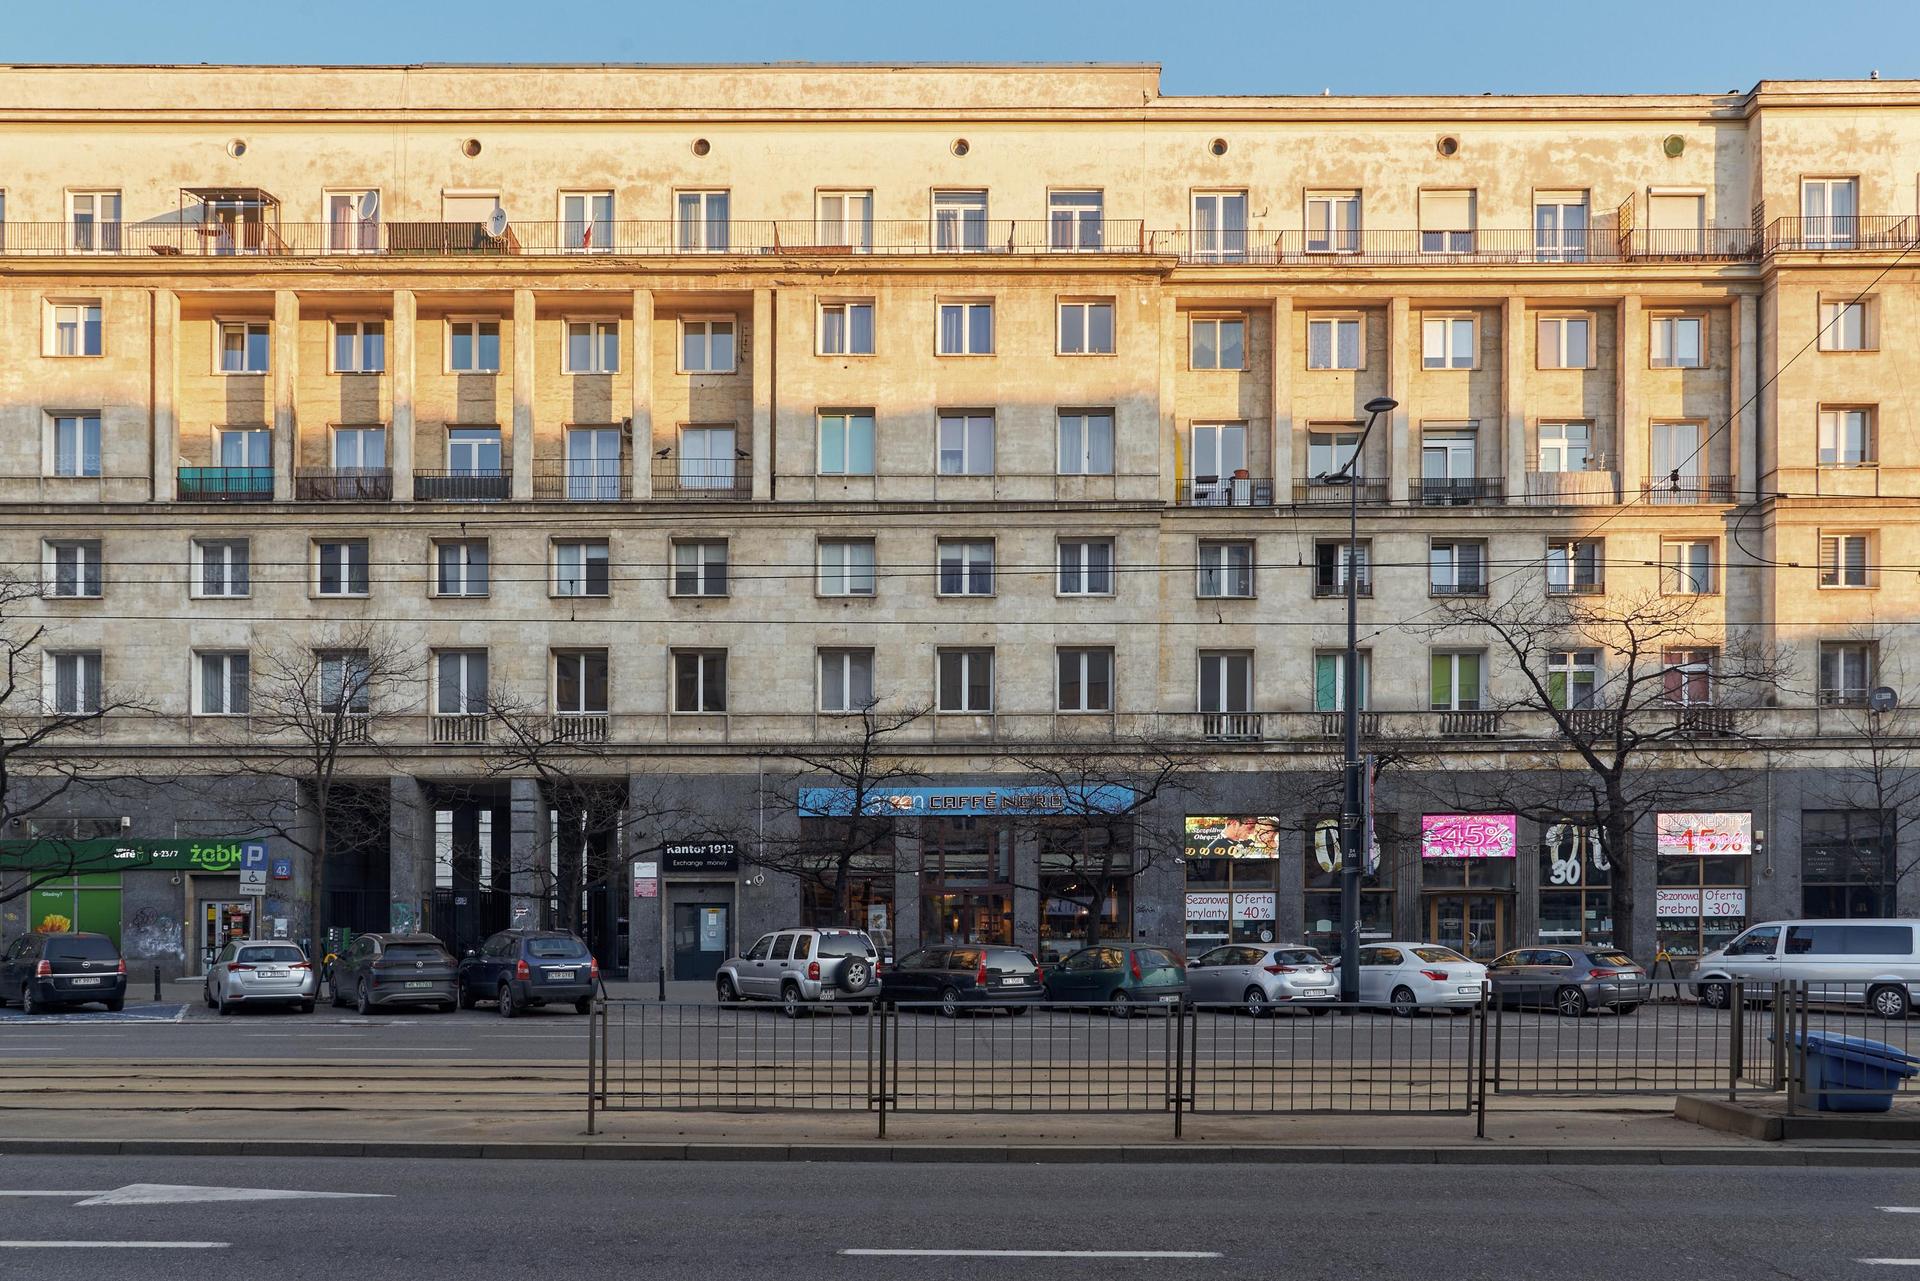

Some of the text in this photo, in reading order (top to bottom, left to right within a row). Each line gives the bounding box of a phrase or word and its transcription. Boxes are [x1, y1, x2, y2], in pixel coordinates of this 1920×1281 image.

[869, 791, 1062, 814] green CAFFÉ NERO
[1428, 824, 1509, 847] -45%
[190, 845, 242, 862] żabk
[666, 845, 734, 854] Kantor 1913
[246, 846, 263, 867] P
[276, 866, 287, 875] 42
[1550, 859, 1580, 885] 30
[1186, 894, 1273, 905] Sezonowa Oferta
[1657, 890, 1743, 901] Sezonowa Oferta
[1186, 908, 1228, 919] brylanty
[1658, 903, 1740, 915] srebro -30%
